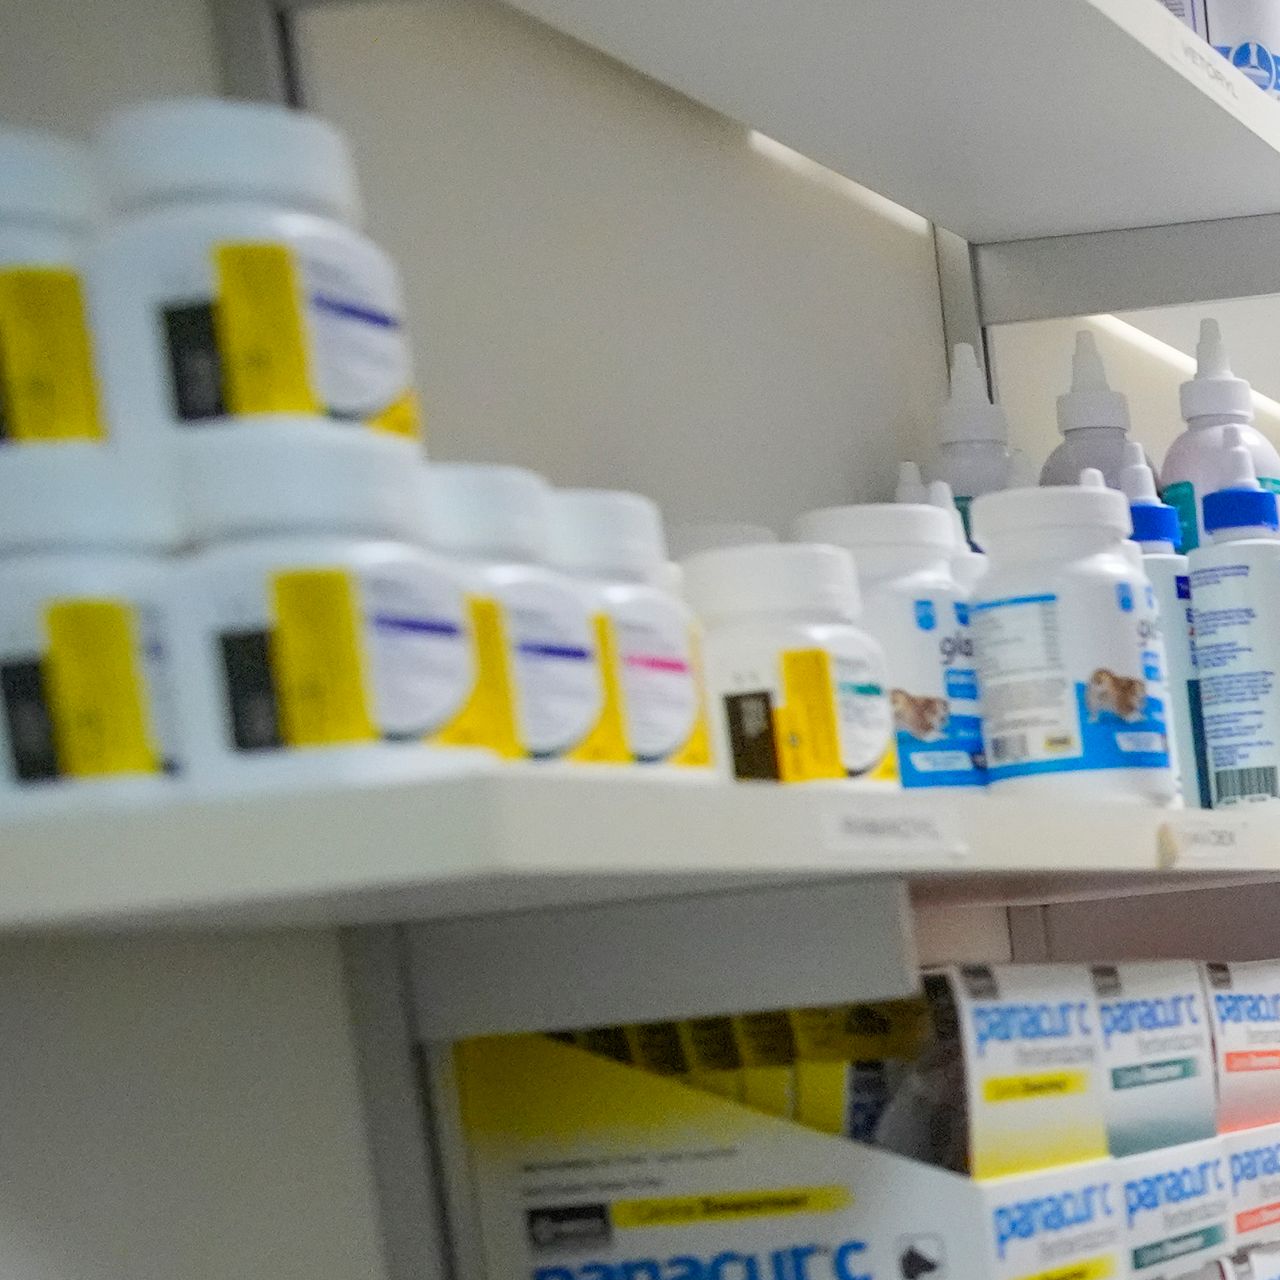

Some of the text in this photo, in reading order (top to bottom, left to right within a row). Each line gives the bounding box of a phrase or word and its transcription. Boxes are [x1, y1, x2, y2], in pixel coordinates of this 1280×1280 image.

[973, 1003, 1070, 1057] panacur
[1100, 996, 1186, 1049] panacur
[992, 1187, 1097, 1260] panacur
[1124, 1162, 1213, 1230] panacur
